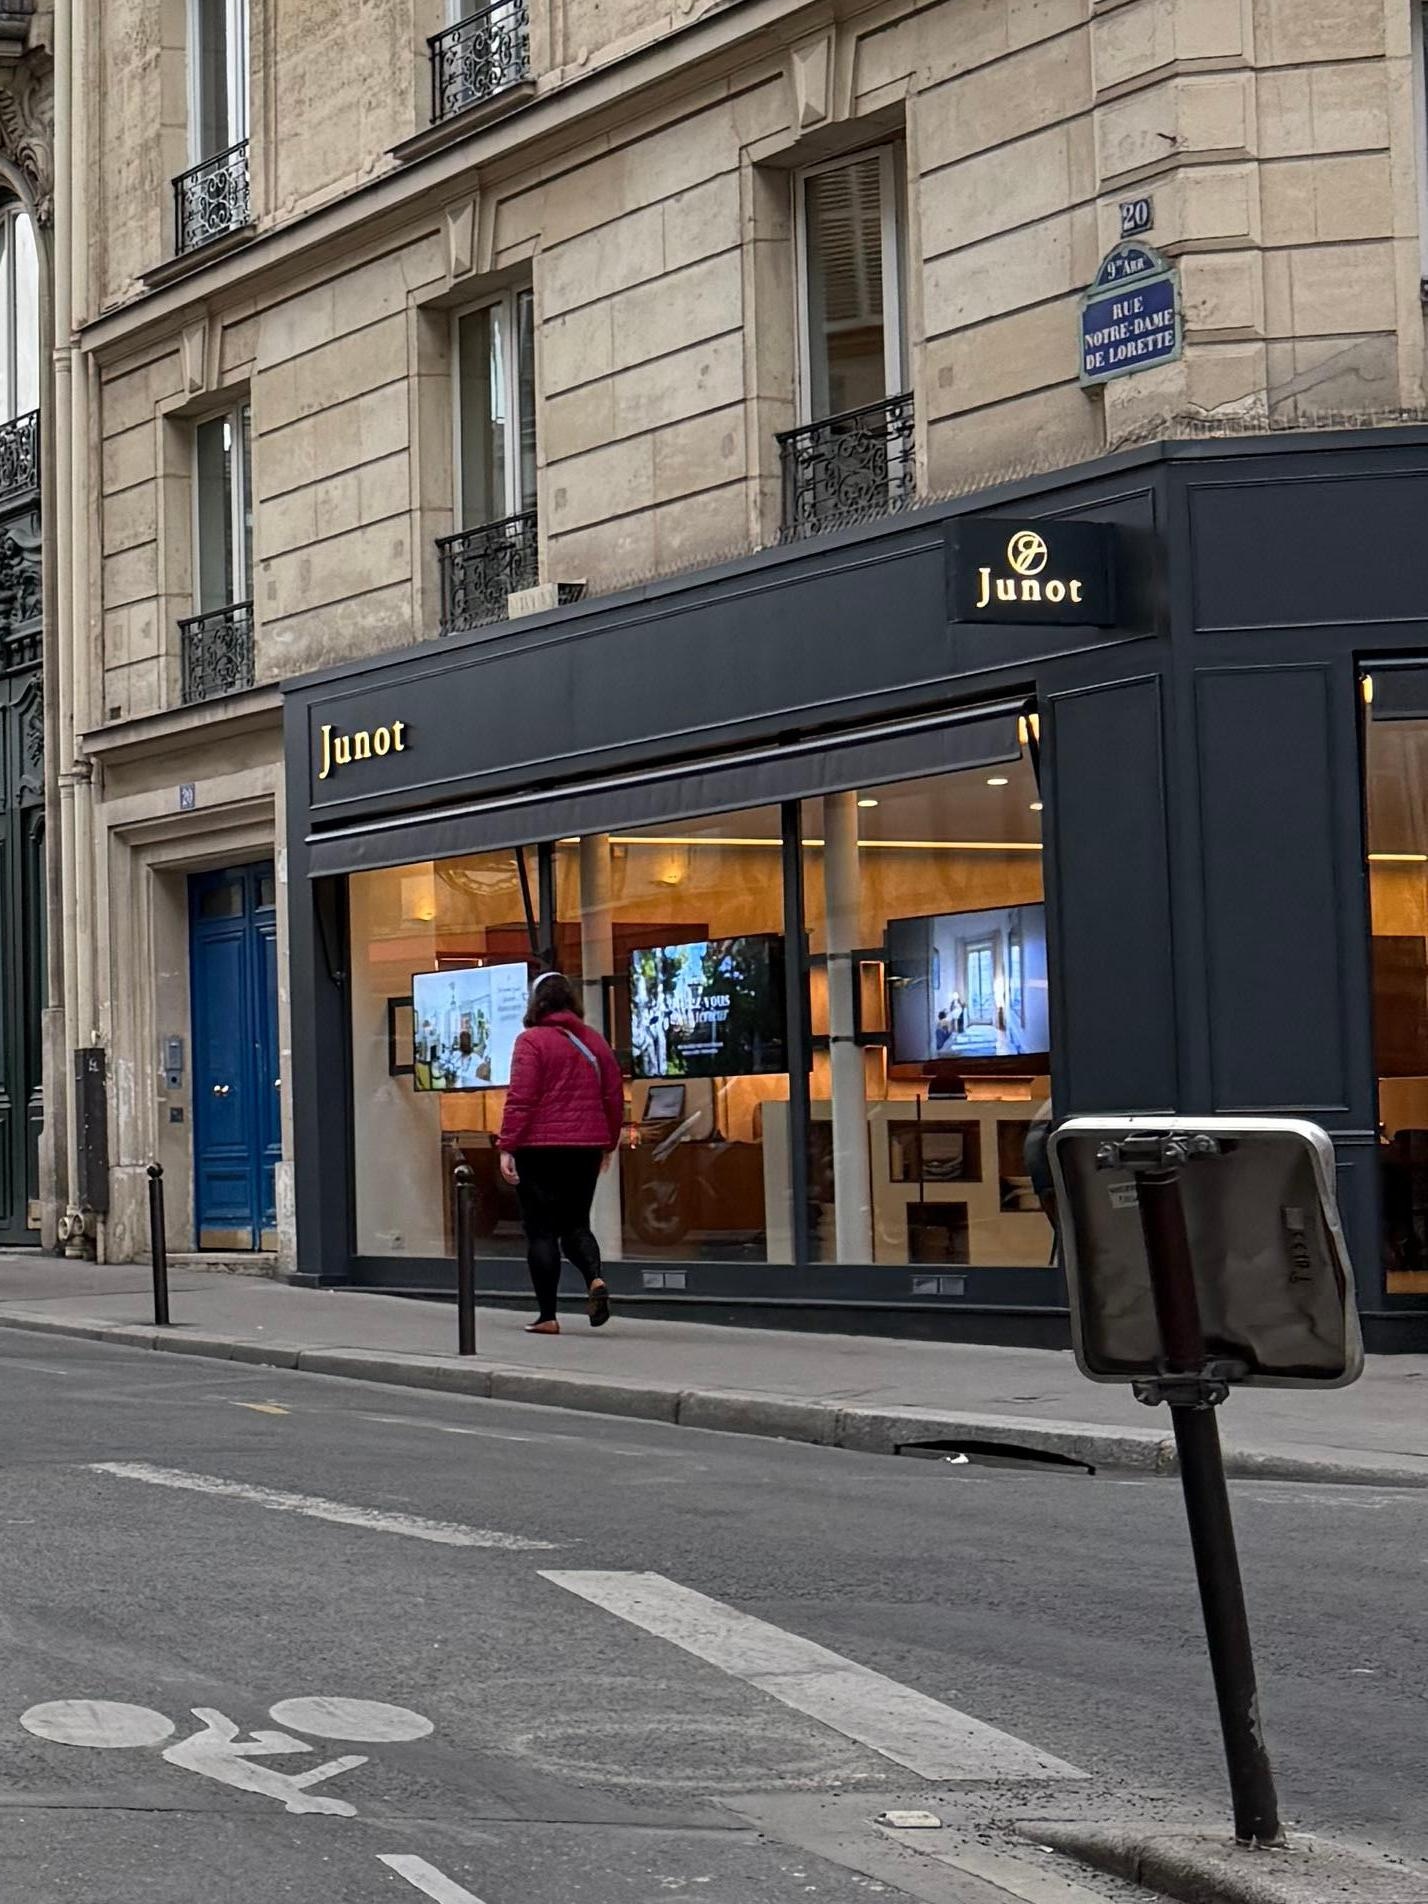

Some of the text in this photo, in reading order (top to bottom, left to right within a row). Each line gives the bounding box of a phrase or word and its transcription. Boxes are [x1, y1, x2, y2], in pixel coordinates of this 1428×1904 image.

[1122, 198, 1148, 230] 20
[1112, 296, 1143, 320] RUE
[1084, 309, 1173, 350] NOTRE-DAME
[1086, 330, 1174, 370] DE LORETTE
[976, 568, 1082, 608] Junot
[319, 720, 404, 779] Junot
